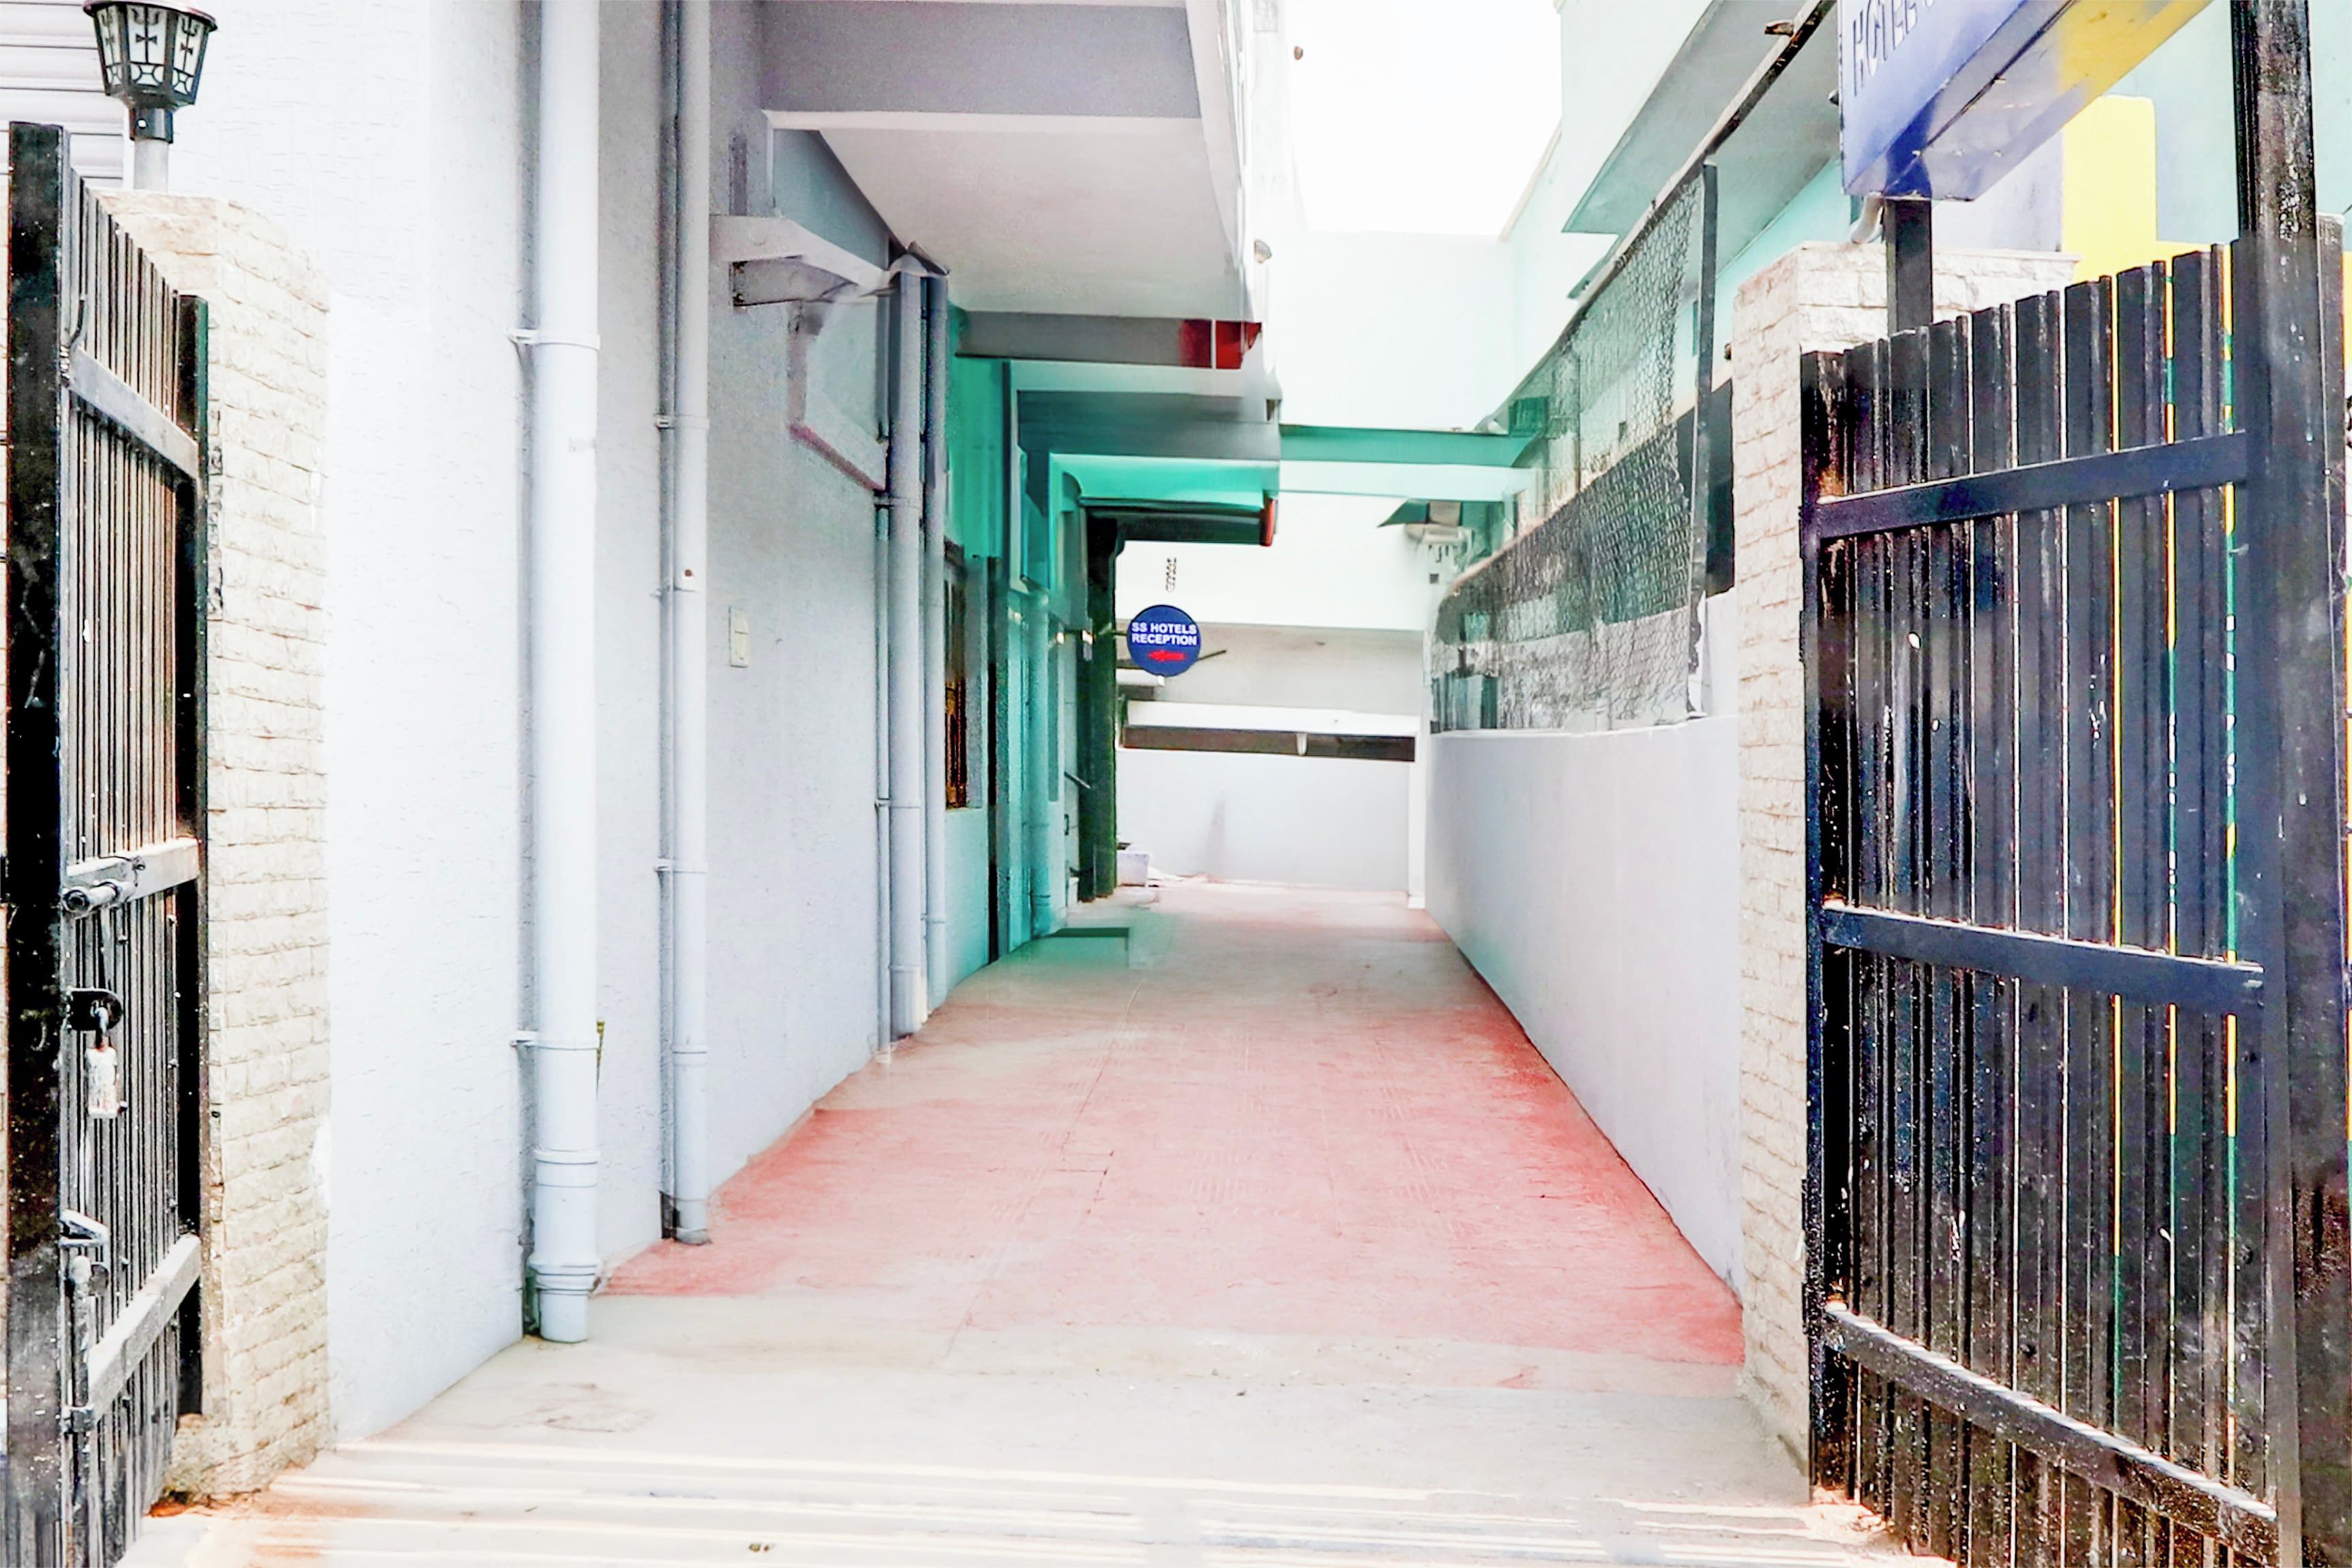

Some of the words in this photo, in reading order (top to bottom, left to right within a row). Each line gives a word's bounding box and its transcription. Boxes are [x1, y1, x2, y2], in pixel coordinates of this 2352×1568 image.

[1132, 622, 1147, 632] SS
[1150, 622, 1197, 634] HOTELS
[1132, 633, 1197, 645] RECEPTION
